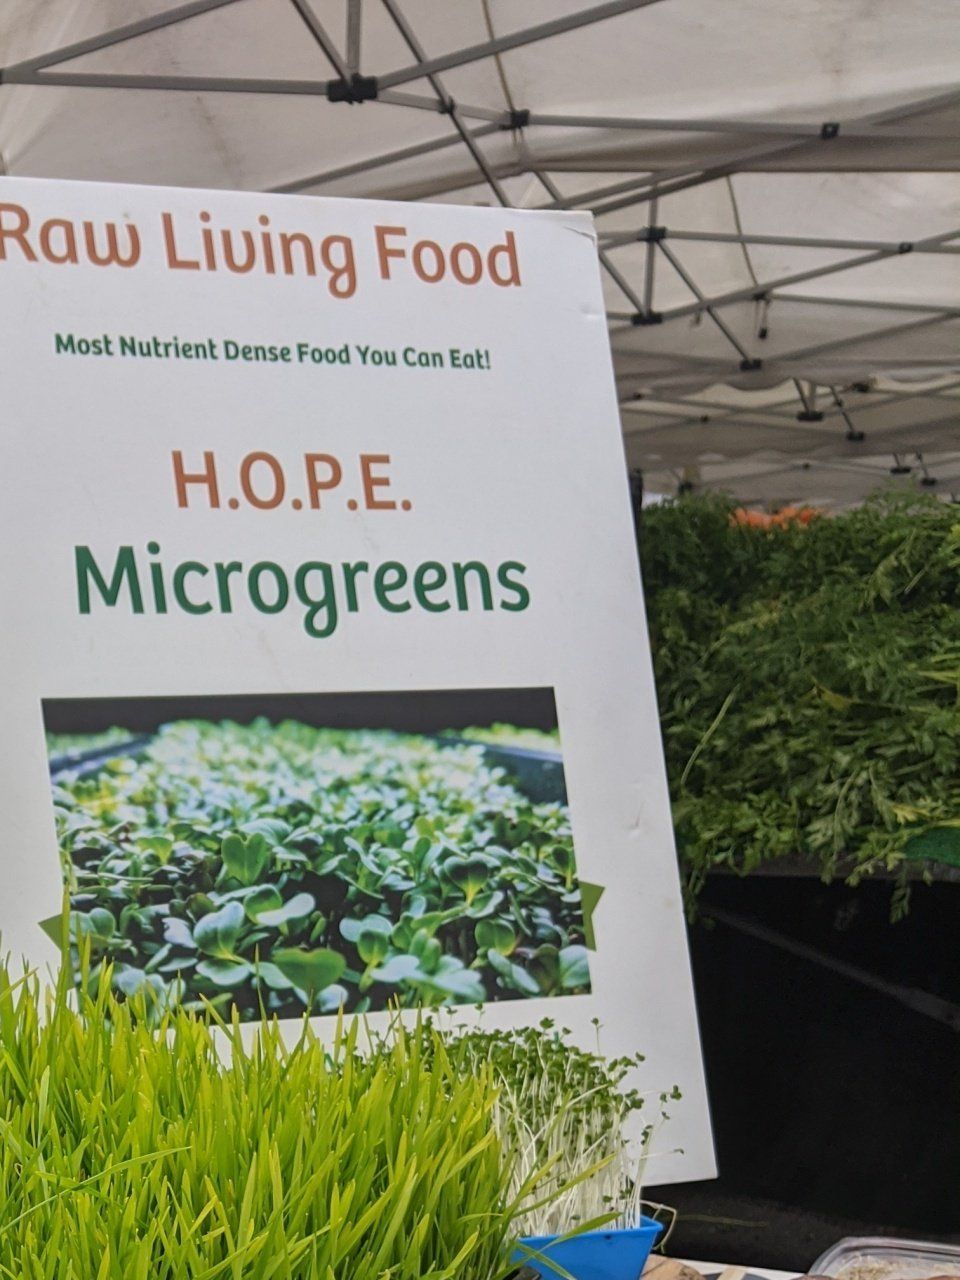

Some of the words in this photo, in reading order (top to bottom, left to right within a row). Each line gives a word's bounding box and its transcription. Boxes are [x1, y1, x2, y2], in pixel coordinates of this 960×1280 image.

[162, 212, 356, 298] Living
[375, 226, 521, 286] Food
[55, 334, 113, 356] Most
[120, 336, 218, 360] Nutrient
[224, 341, 291, 362] Dense
[297, 343, 350, 364] Food
[356, 346, 397, 366] You
[403, 347, 443, 367] Can
[450, 349, 490, 369] Eat!
[172, 451, 411, 511] H.O.P.E.
[75, 541, 530, 638] Microgreens
